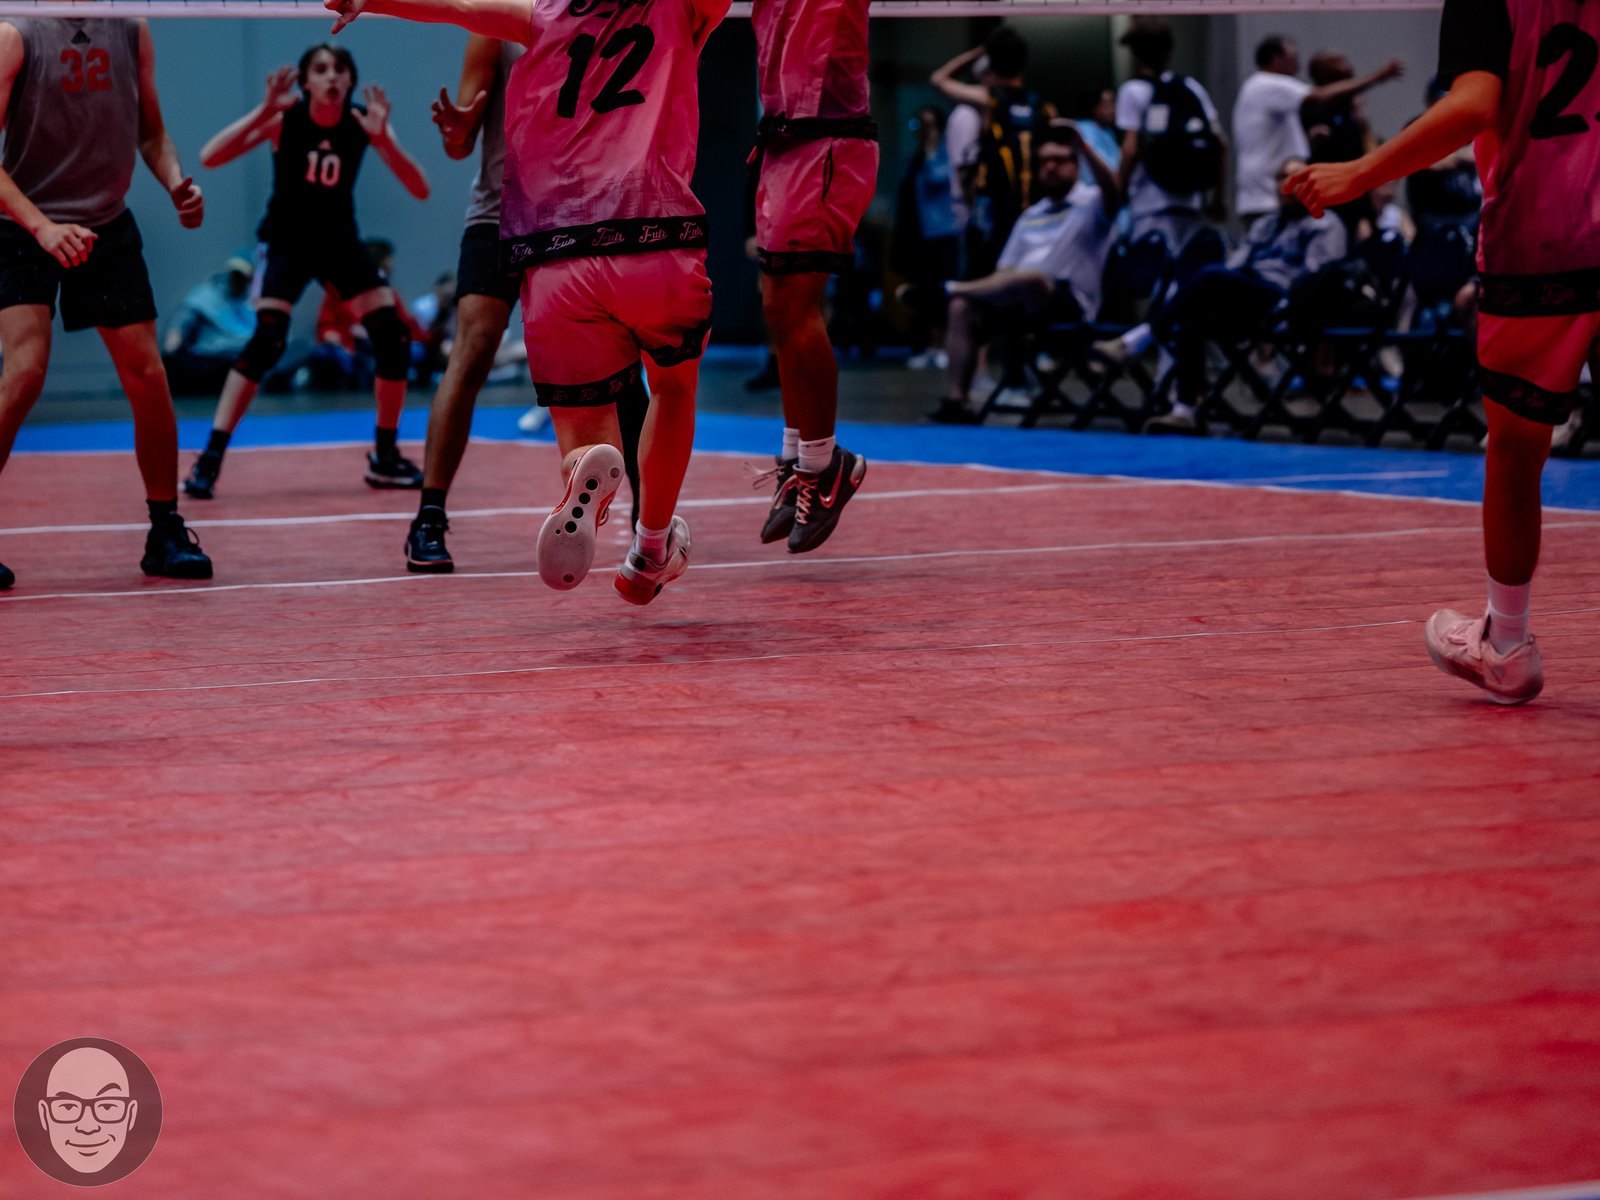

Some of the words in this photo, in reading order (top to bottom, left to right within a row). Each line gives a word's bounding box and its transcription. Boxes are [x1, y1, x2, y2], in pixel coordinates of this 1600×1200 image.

[60, 48, 112, 93] 32
[557, 23, 655, 118] 12
[1530, 23, 1600, 139] 2
[305, 149, 342, 188] 10
